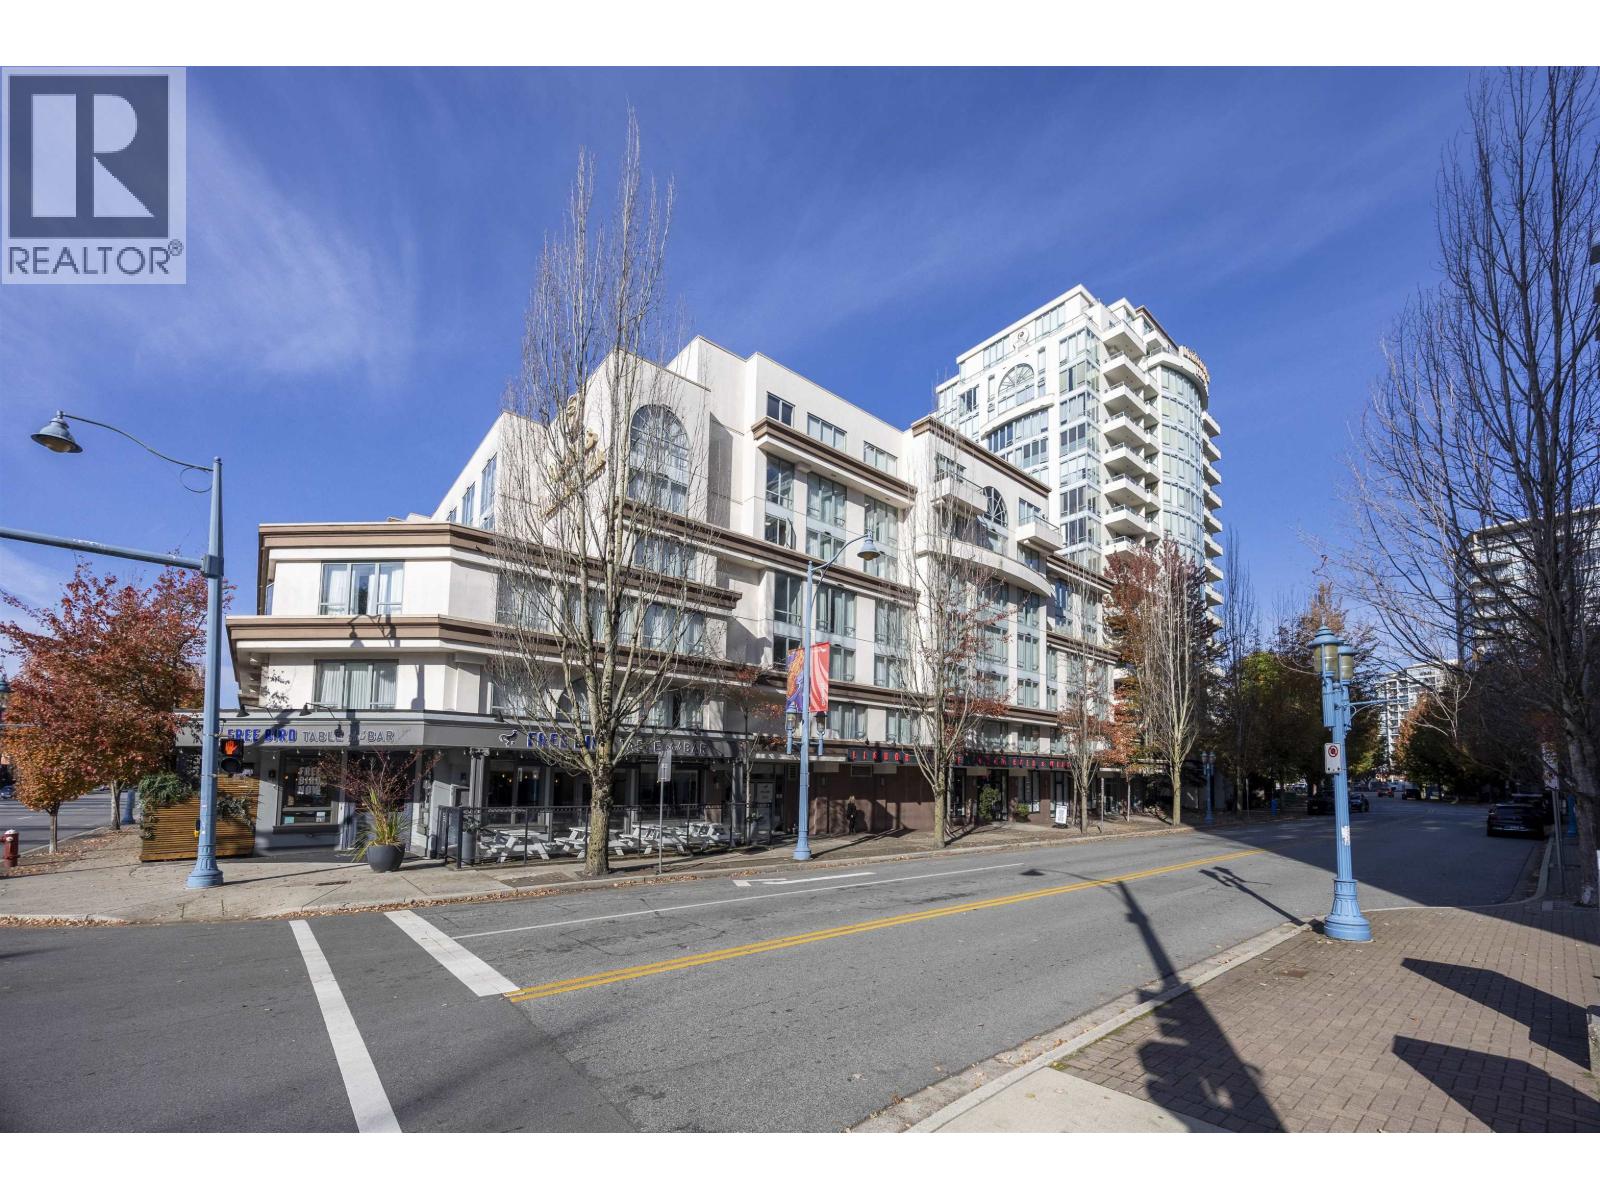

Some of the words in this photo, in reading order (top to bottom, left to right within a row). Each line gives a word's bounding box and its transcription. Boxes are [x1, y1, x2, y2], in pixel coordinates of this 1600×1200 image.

[227, 728, 260, 743] FREE
[264, 728, 298, 743] BIRD
[302, 731, 344, 743] TABLE
[367, 730, 395, 743] BAR
